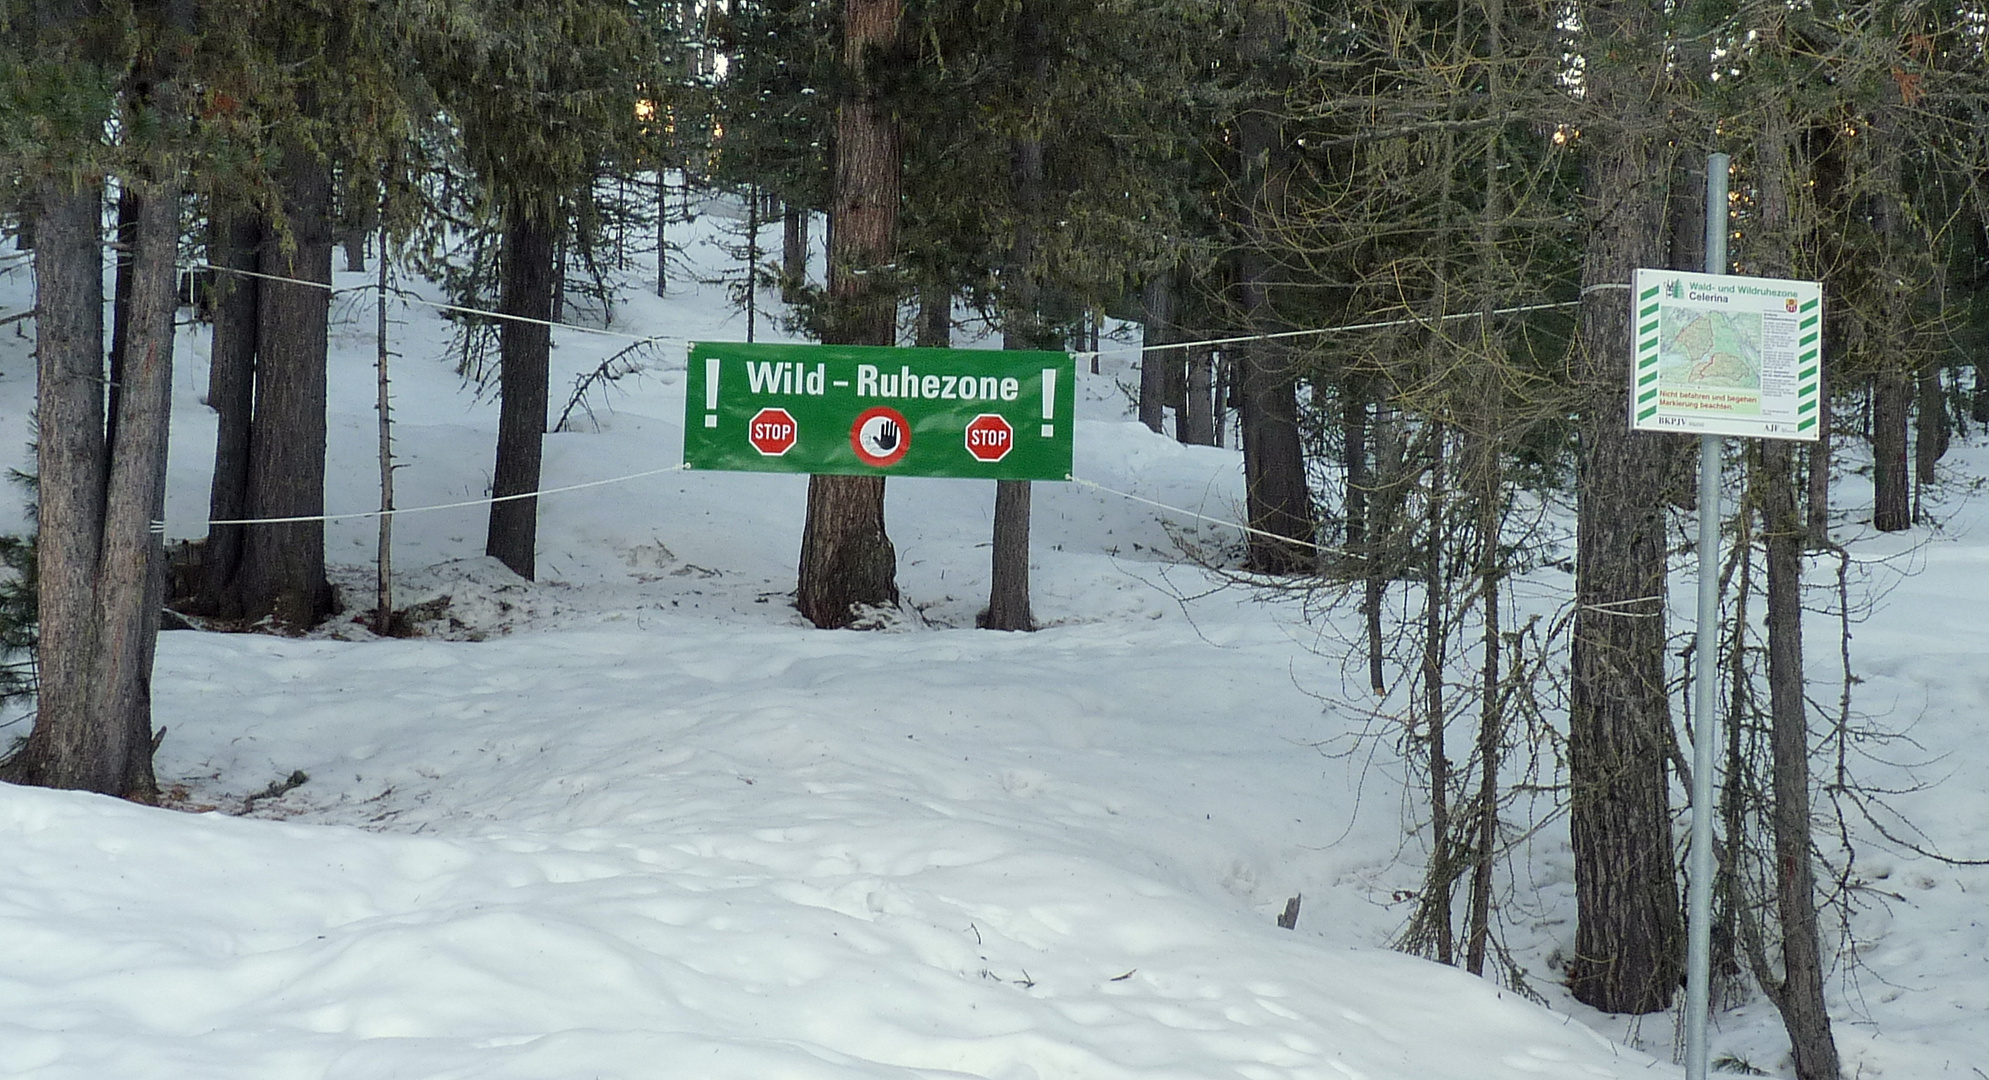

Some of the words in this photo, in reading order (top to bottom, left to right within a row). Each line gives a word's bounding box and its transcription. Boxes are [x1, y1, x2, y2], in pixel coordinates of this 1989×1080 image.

[1689, 282, 1715, 292] Wald-
[1718, 284, 1735, 293] und
[1738, 285, 1798, 298] Wildruhezone
[1689, 291, 1729, 303] Celerina
[746, 361, 825, 395] Wild
[857, 364, 1019, 400] Ruhezone
[705, 358, 720, 428] !
[1659, 390, 1678, 398] Nicht
[1679, 392, 1710, 401] befahren
[1727, 395, 1757, 404] begehen
[1041, 368, 1057, 437] !
[1659, 398, 1698, 409] Markierung
[1700, 400, 1733, 410] beachten.
[1658, 416, 1687, 426] BKPJV
[755, 423, 791, 440] STOP
[971, 429, 1008, 446] STOP
